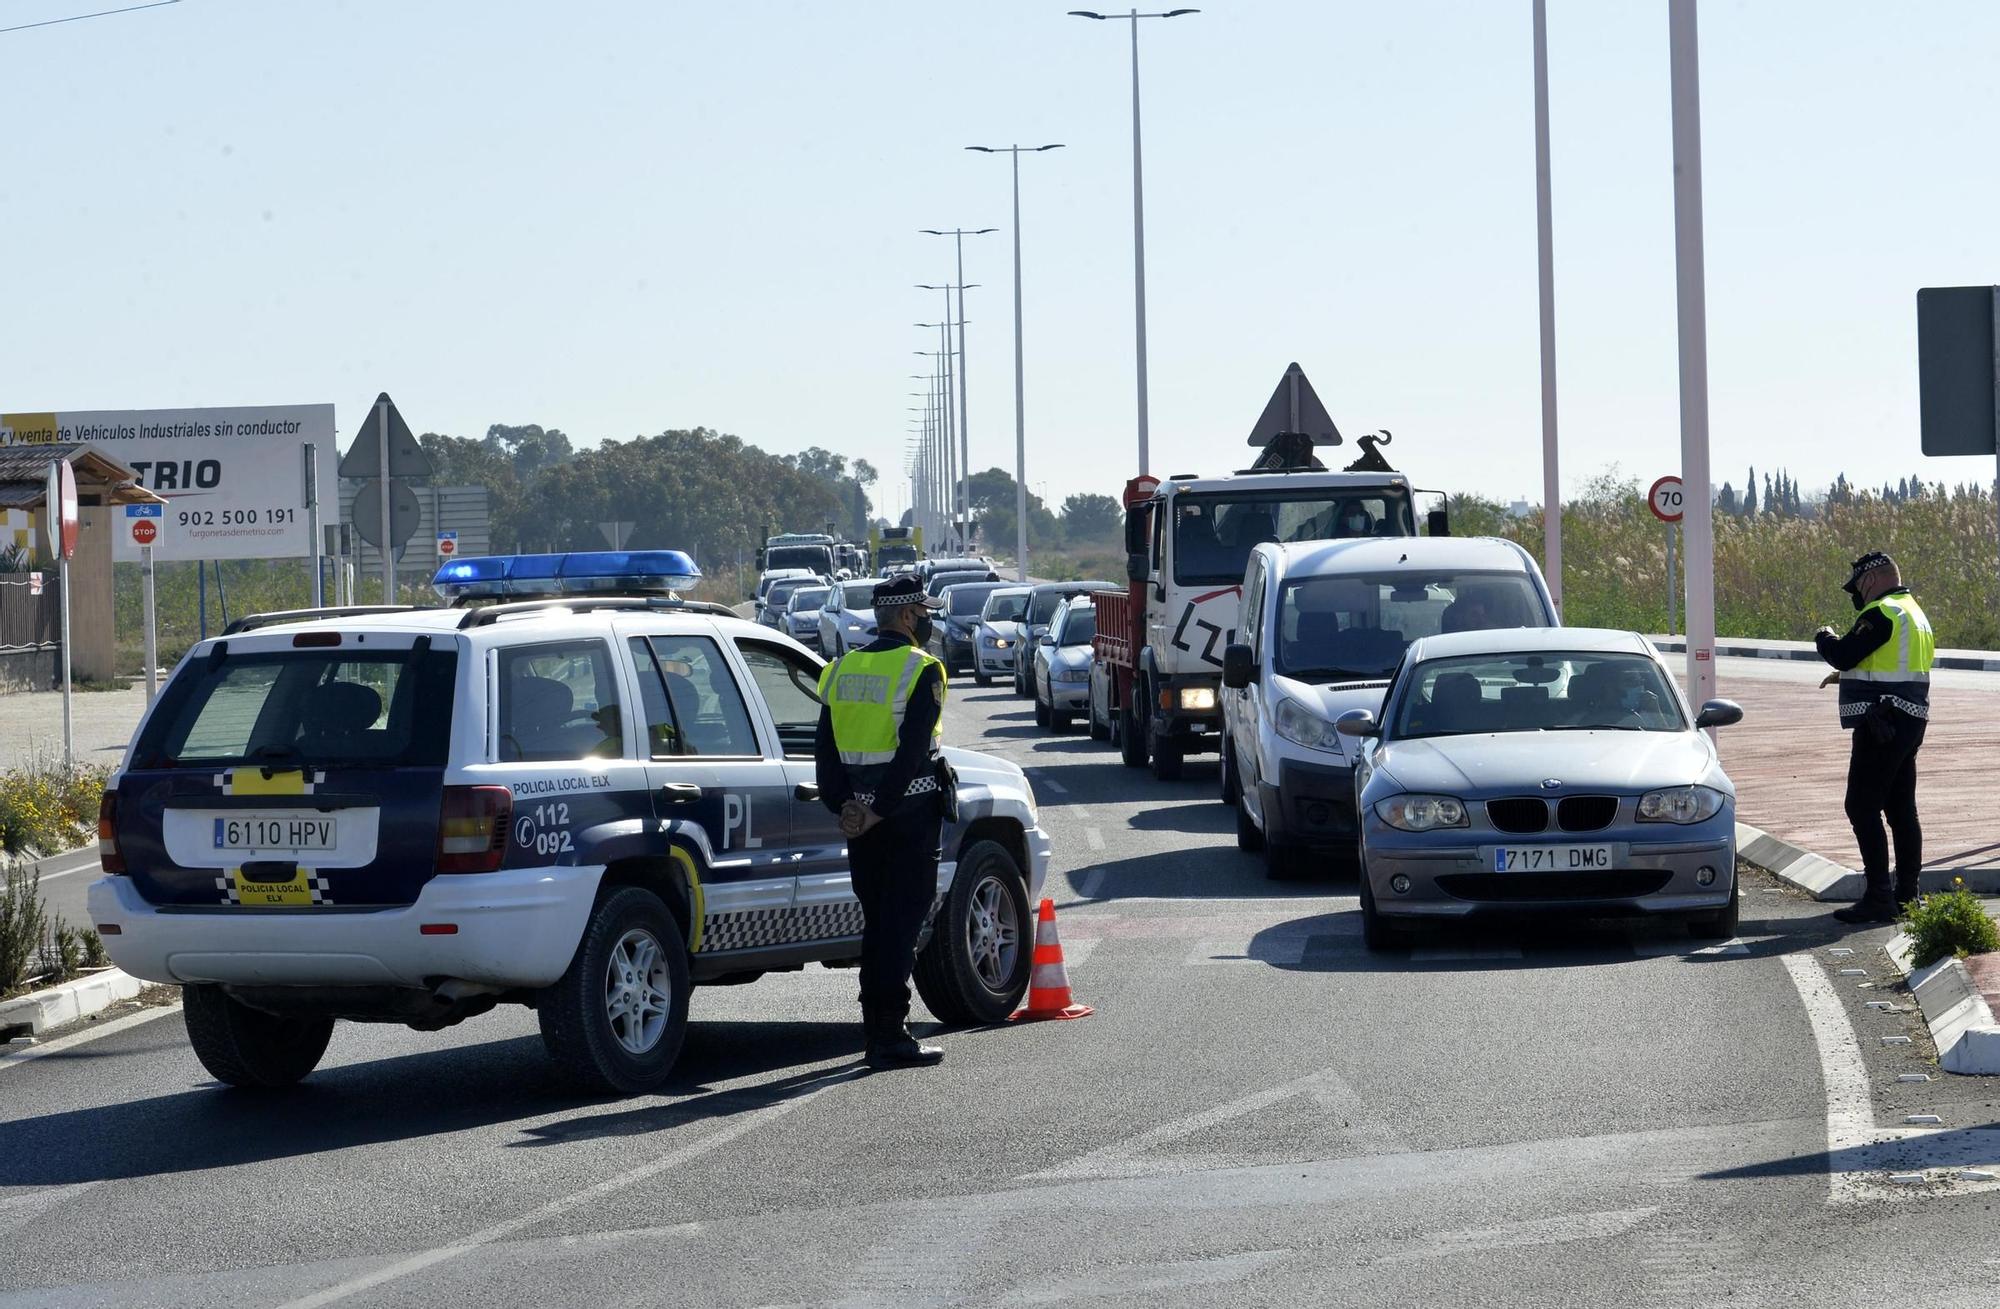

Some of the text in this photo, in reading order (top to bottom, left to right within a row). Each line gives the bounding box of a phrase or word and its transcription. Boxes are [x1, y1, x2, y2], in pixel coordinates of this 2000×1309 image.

[9, 431, 16, 444] y
[19, 428, 53, 442] venta
[56, 425, 71, 441] de
[75, 423, 136, 440] Vehículos
[139, 421, 211, 438] Industriales
[214, 421, 233, 436] sin
[237, 419, 302, 435] conductor
[1660, 491, 1683, 506] 70
[179, 508, 294, 526] 902 500 191
[134, 528, 156, 536] STOP
[189, 527, 285, 540] furgonetasdemetrio.com
[513, 775, 611, 796] POLICIA LOCAL ELX
[535, 803, 570, 827] 112
[723, 794, 762, 849] PL
[228, 822, 330, 845] 6110 HPV
[536, 831, 575, 855] 092
[1506, 848, 1608, 869] 7171 DMG
[241, 885, 305, 893] POLICIA LOCAL
